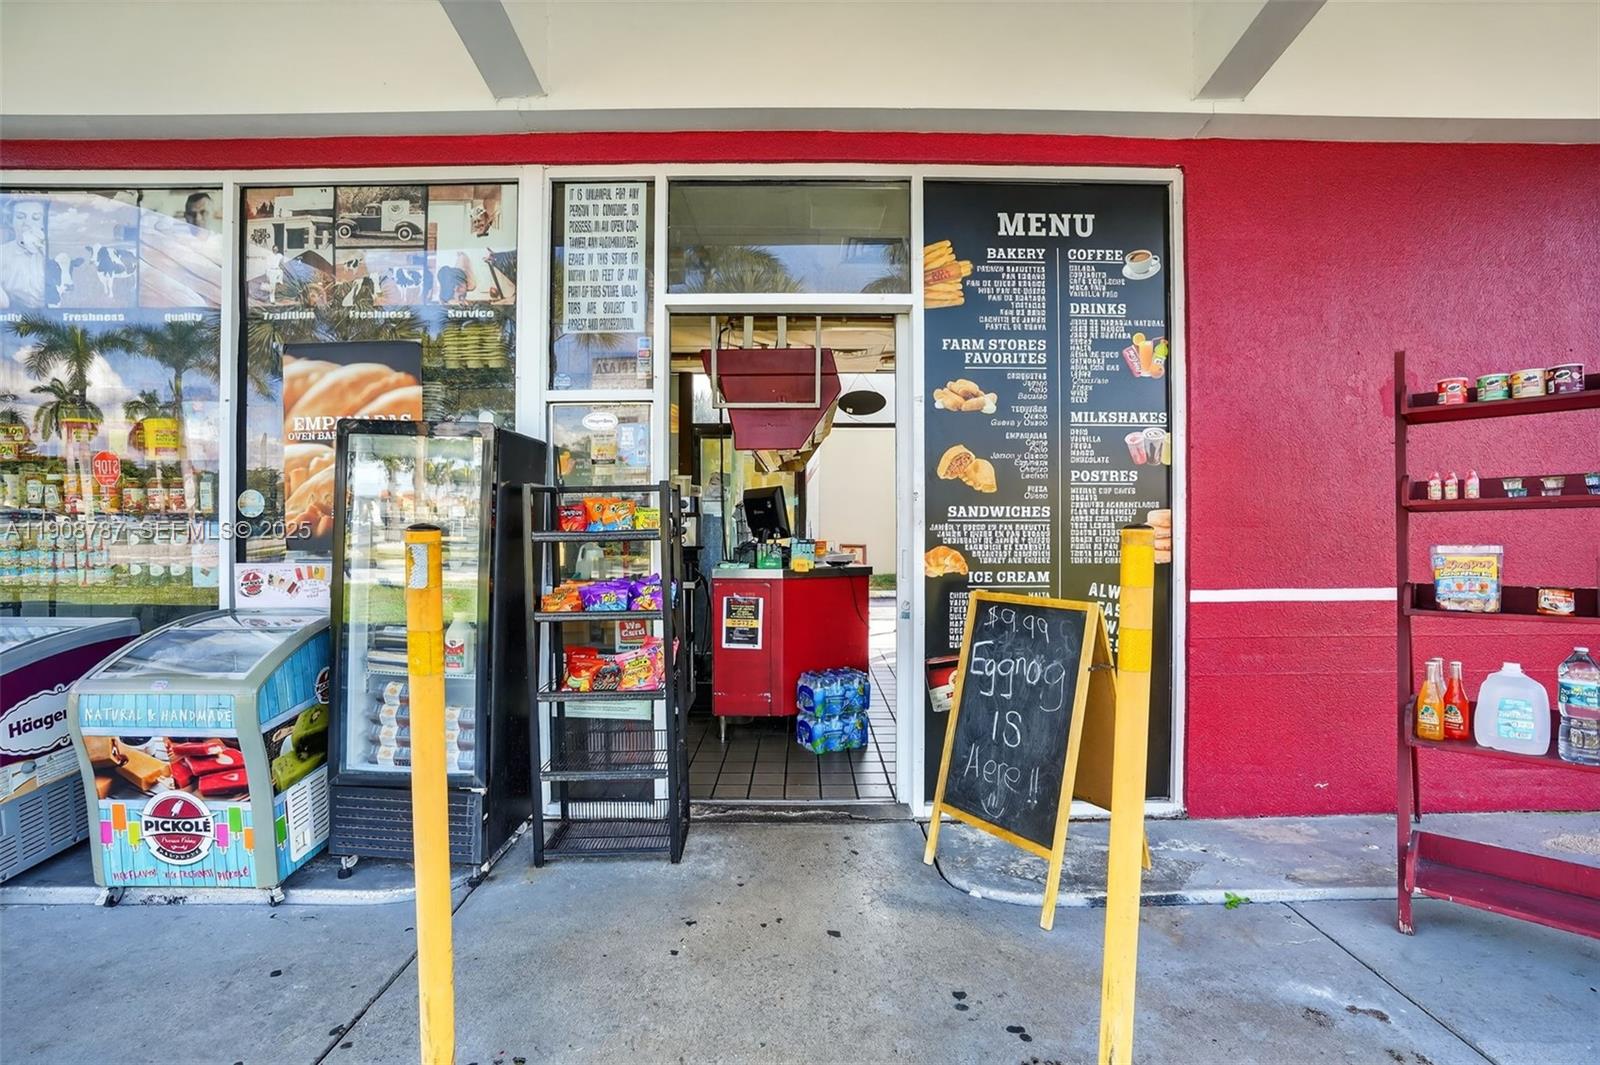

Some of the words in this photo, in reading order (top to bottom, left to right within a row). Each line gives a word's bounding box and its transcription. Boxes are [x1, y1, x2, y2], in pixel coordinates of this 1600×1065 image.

[996, 212, 1096, 238] MENU
[986, 247, 1046, 260] BAKERY
[1068, 248, 1124, 261] COFFEE
[448, 308, 494, 318] Service
[1069, 303, 1128, 315] DRINKS
[942, 338, 984, 351] FARM
[988, 338, 1046, 351] STORES
[964, 352, 1046, 364] FAVORITES
[1070, 412, 1168, 424] MILKSHAKES
[288, 432, 318, 442] OVEN
[1070, 470, 1138, 482] POSTRES
[947, 505, 1051, 518] SANDWICHES
[968, 571, 992, 583] ICE
[996, 571, 1050, 583] CREAM
[1088, 582, 1121, 598] ALW
[983, 605, 1050, 644] $9.99
[969, 639, 1067, 713] Eggnog
[85, 708, 143, 722] NATURAL
[147, 708, 156, 722] &
[161, 708, 233, 722] HANDMADE
[144, 818, 211, 833] PICKOLÉ
